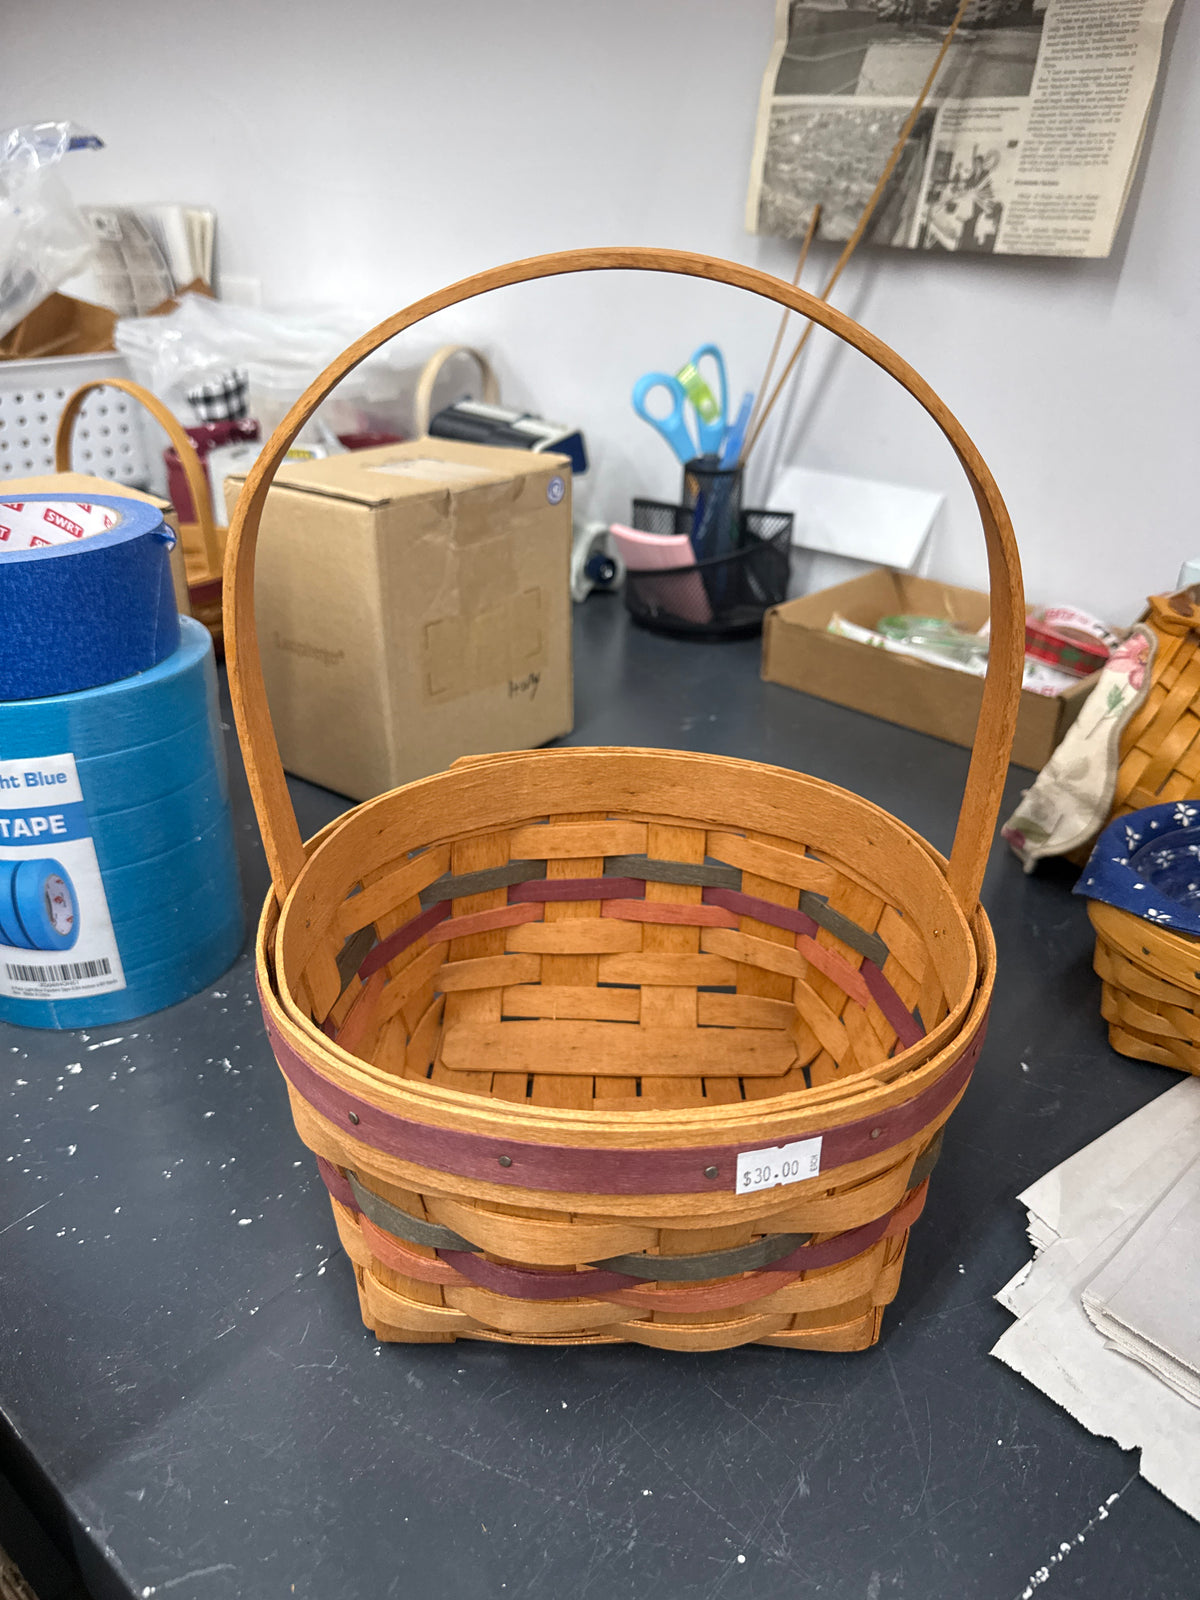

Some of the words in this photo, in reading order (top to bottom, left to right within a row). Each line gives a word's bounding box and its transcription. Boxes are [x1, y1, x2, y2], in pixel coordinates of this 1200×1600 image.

[46, 510, 82, 537] SWRT
[23, 771, 68, 787] Blue
[0, 814, 67, 838] TAPE
[743, 1160, 799, 1187] $30.00
